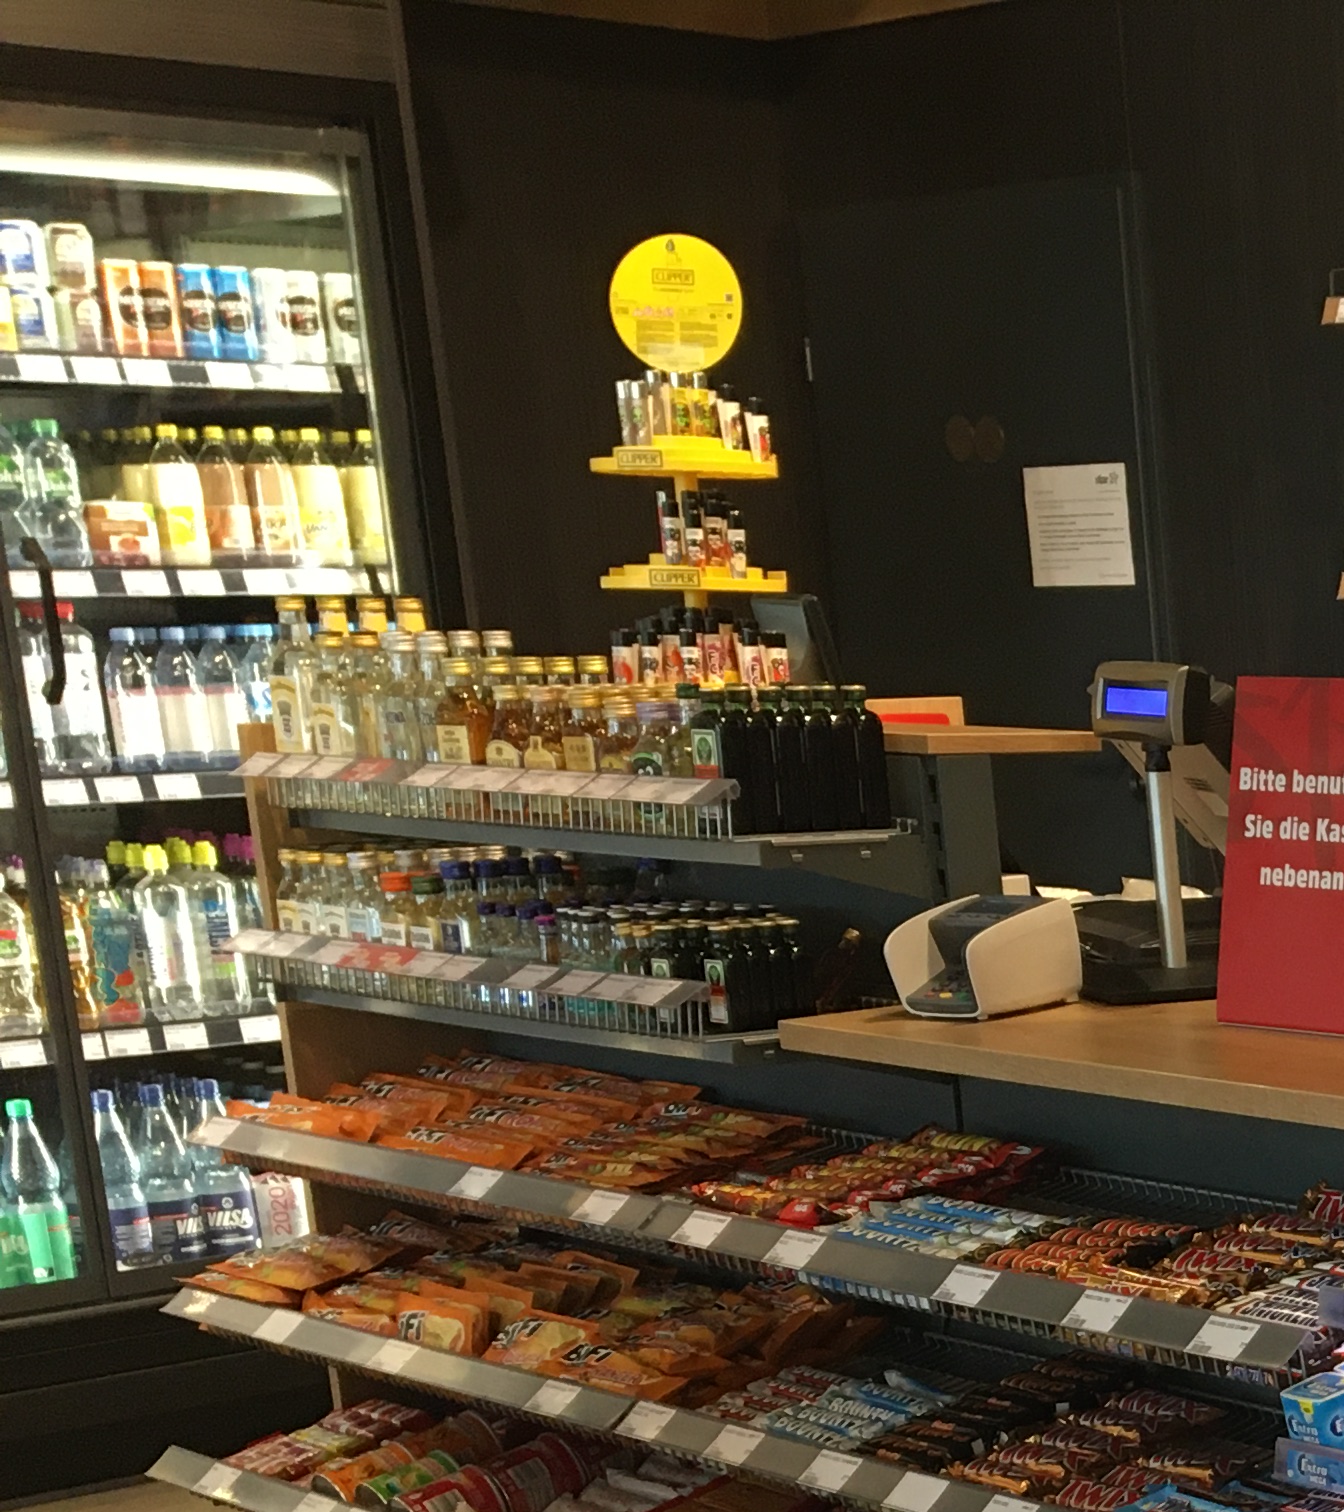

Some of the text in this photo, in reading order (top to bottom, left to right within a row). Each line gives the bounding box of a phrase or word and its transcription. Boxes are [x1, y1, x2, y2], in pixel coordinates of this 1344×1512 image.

[652, 570, 698, 585] CLIPPER
[1239, 767, 1287, 793] Bitte
[1244, 814, 1273, 840] Sie
[1279, 816, 1309, 842] die
